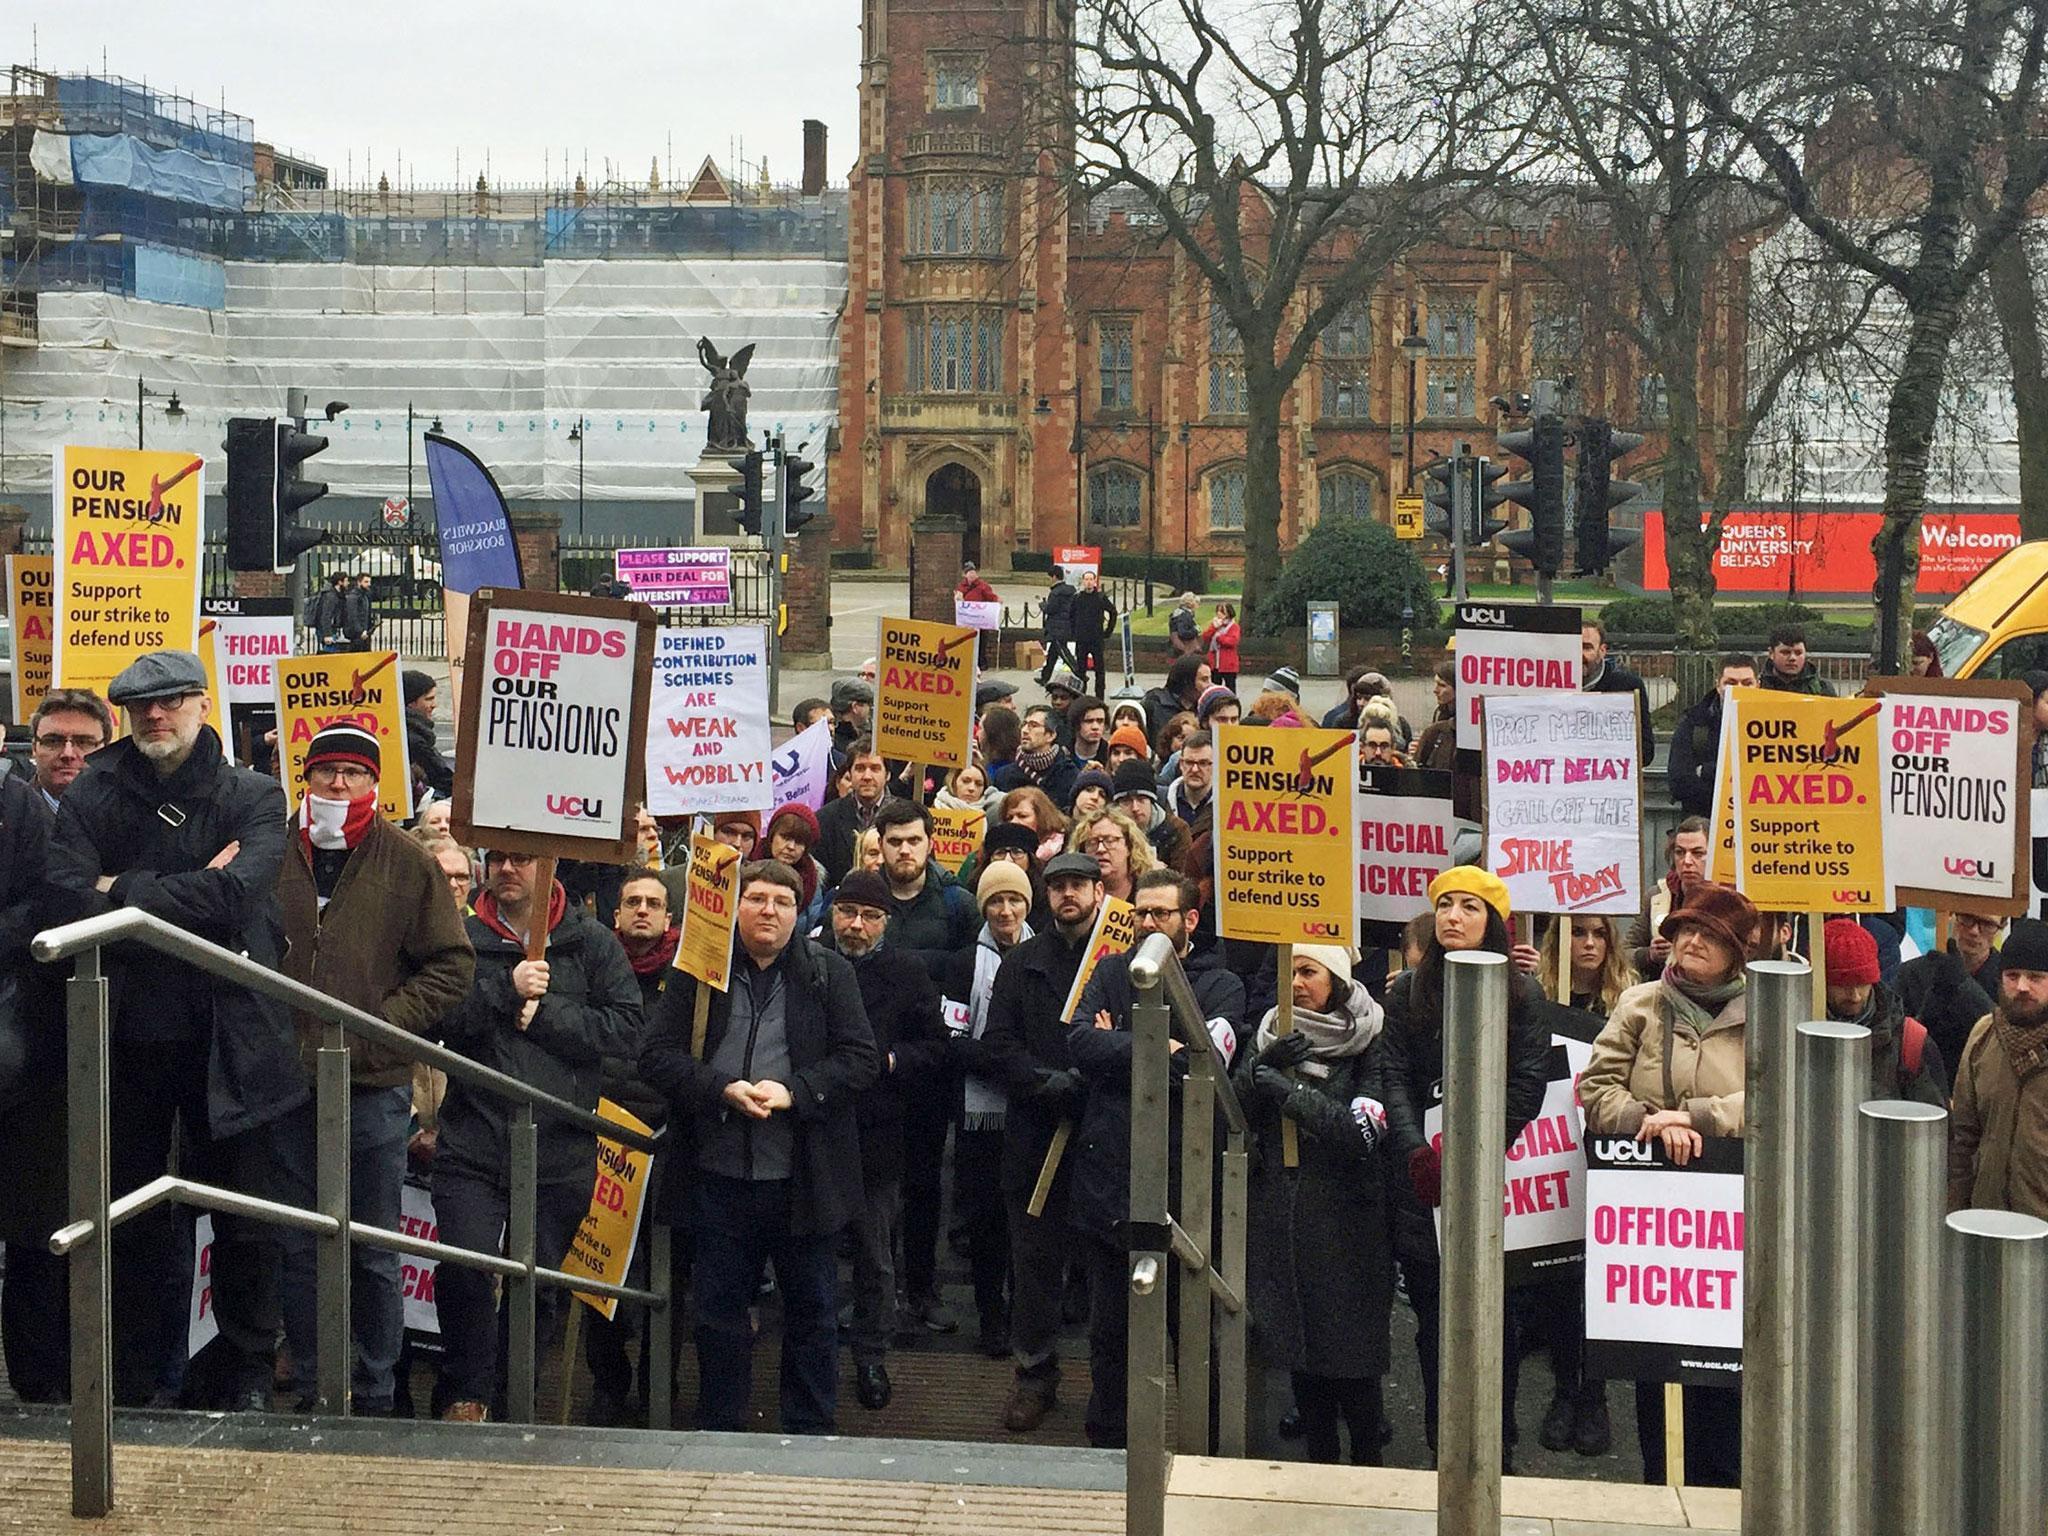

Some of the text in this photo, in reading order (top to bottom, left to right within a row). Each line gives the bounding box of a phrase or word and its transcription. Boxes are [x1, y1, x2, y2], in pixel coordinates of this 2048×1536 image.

[72, 468, 125, 492] OUR
[72, 496, 182, 525] PENSION
[1721, 525, 1786, 539] QUEEN'S
[71, 531, 185, 569] AXED.
[1720, 540, 1813, 555] UNIVERSITY
[620, 552, 725, 565] PLEASE SUPPORT
[1720, 555, 1777, 568] BELFAST
[20, 570, 53, 587] OU
[635, 573, 663, 583] FAIR
[666, 571, 698, 582] DEAL
[701, 571, 725, 582] FOR
[71, 582, 142, 602] Support
[624, 590, 691, 602] NIVERSITY
[70, 607, 170, 623] our strike to
[70, 630, 164, 646] defend USS
[224, 635, 289, 655] FICIAL
[496, 621, 626, 658] HANDS
[663, 636, 725, 651] DEFINED
[886, 630, 921, 647] OUR
[494, 649, 561, 679] OFF
[653, 653, 757, 669] CONTRIBUTION
[886, 646, 960, 670] PENSION
[227, 665, 271, 685] ICKE
[286, 672, 329, 689] OUR
[664, 672, 734, 687] SCHEMES
[884, 666, 962, 697] AXED.
[1461, 655, 1576, 689] OFFICIAL
[492, 678, 558, 699] OUR
[287, 689, 382, 709] PENSION
[684, 693, 716, 707] ARE
[883, 696, 929, 712] Support
[488, 697, 620, 757] PENSIONS
[667, 717, 738, 738] WEAK
[882, 712, 951, 728] our strike to
[1490, 713, 1540, 747] PROF.
[1746, 720, 1797, 739] OUR
[1893, 705, 2009, 735] HANDS
[882, 724, 946, 742] defend USS
[1892, 729, 1951, 755] OFF
[693, 742, 722, 756] AND
[1226, 745, 1274, 766] OUR
[1747, 744, 1860, 765] PENSION
[664, 761, 763, 785] WOBBLY!
[1564, 757, 1631, 784] DELAY
[1891, 754, 1950, 773] OUR
[1226, 770, 1334, 795] PENSION
[1748, 774, 1867, 805] AXED.
[1890, 771, 2006, 824] PENSIONS
[1226, 800, 1339, 837] AXED.
[1496, 796, 1633, 828] CALL OFF THE
[1750, 818, 1820, 836] Support
[1361, 821, 1448, 856] FICIAL
[1750, 840, 1855, 854] our strike to
[694, 845, 711, 864] OUR
[1227, 845, 1293, 865] Support
[1496, 837, 1573, 878] STRIKE
[1227, 869, 1325, 886] our strike to
[1752, 860, 1850, 876] defend USS
[1360, 863, 1440, 897] ICKET
[1548, 863, 1622, 905] TODAY
[689, 881, 729, 918] AXED.
[1228, 888, 1320, 908] defend USS
[600, 1243, 612, 1258] to
[1606, 1264, 1737, 1310] PICKET
